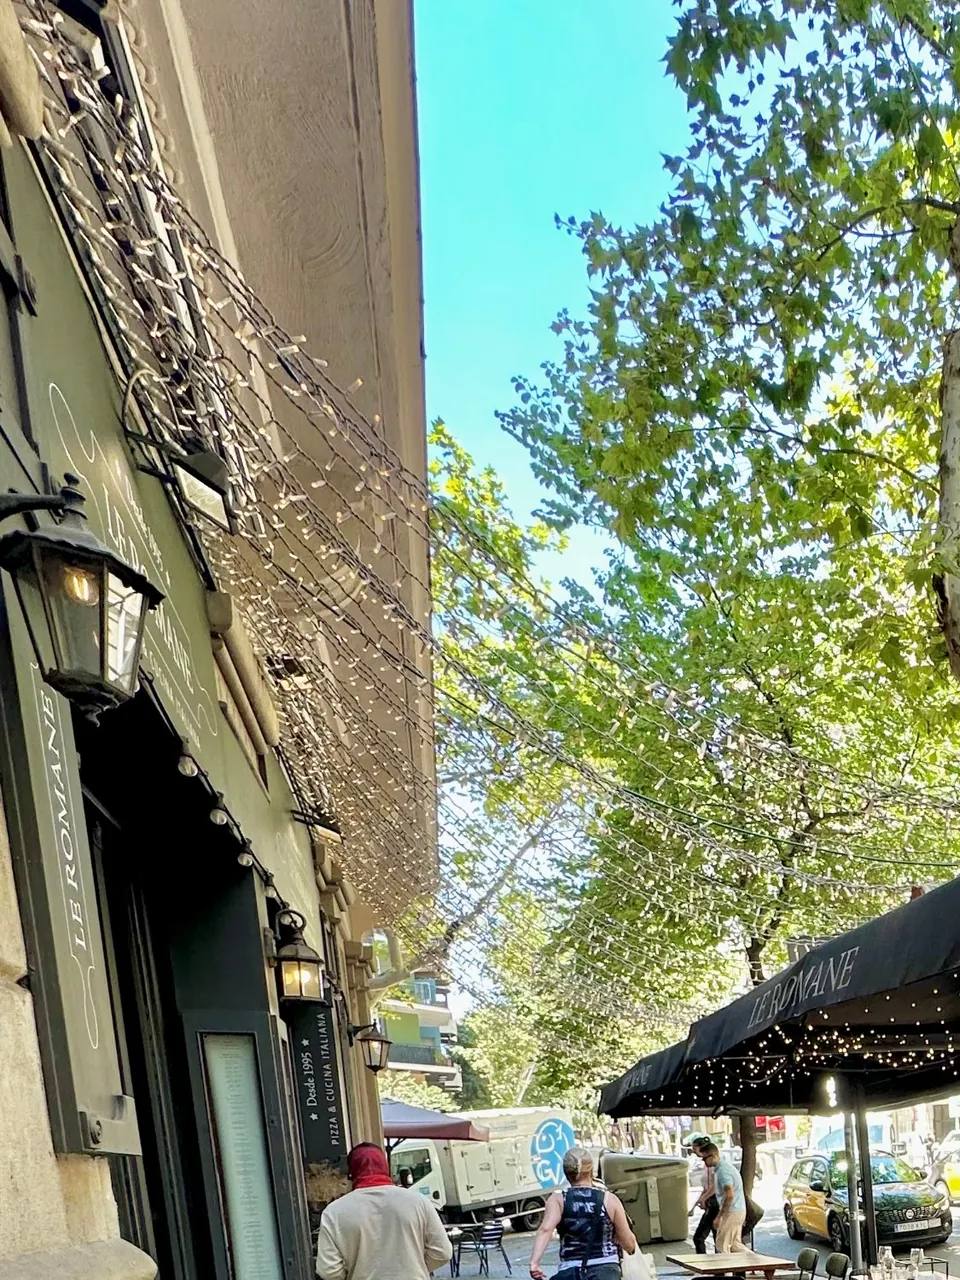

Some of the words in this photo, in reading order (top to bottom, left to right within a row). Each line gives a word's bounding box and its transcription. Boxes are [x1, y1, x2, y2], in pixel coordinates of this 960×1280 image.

[102, 482, 130, 565] LE
[40, 689, 79, 892] ROMANE
[71, 899, 87, 951] LE
[747, 990, 771, 1029] LE
[767, 946, 860, 1019] ROMANE
[317, 1013, 330, 1059] ITALIANA
[301, 1051, 314, 1075] 1995
[323, 1063, 335, 1101] CUCINA
[304, 1078, 318, 1107] Desde
[328, 1105, 337, 1113] &
[329, 1117, 340, 1145] PIZZA
